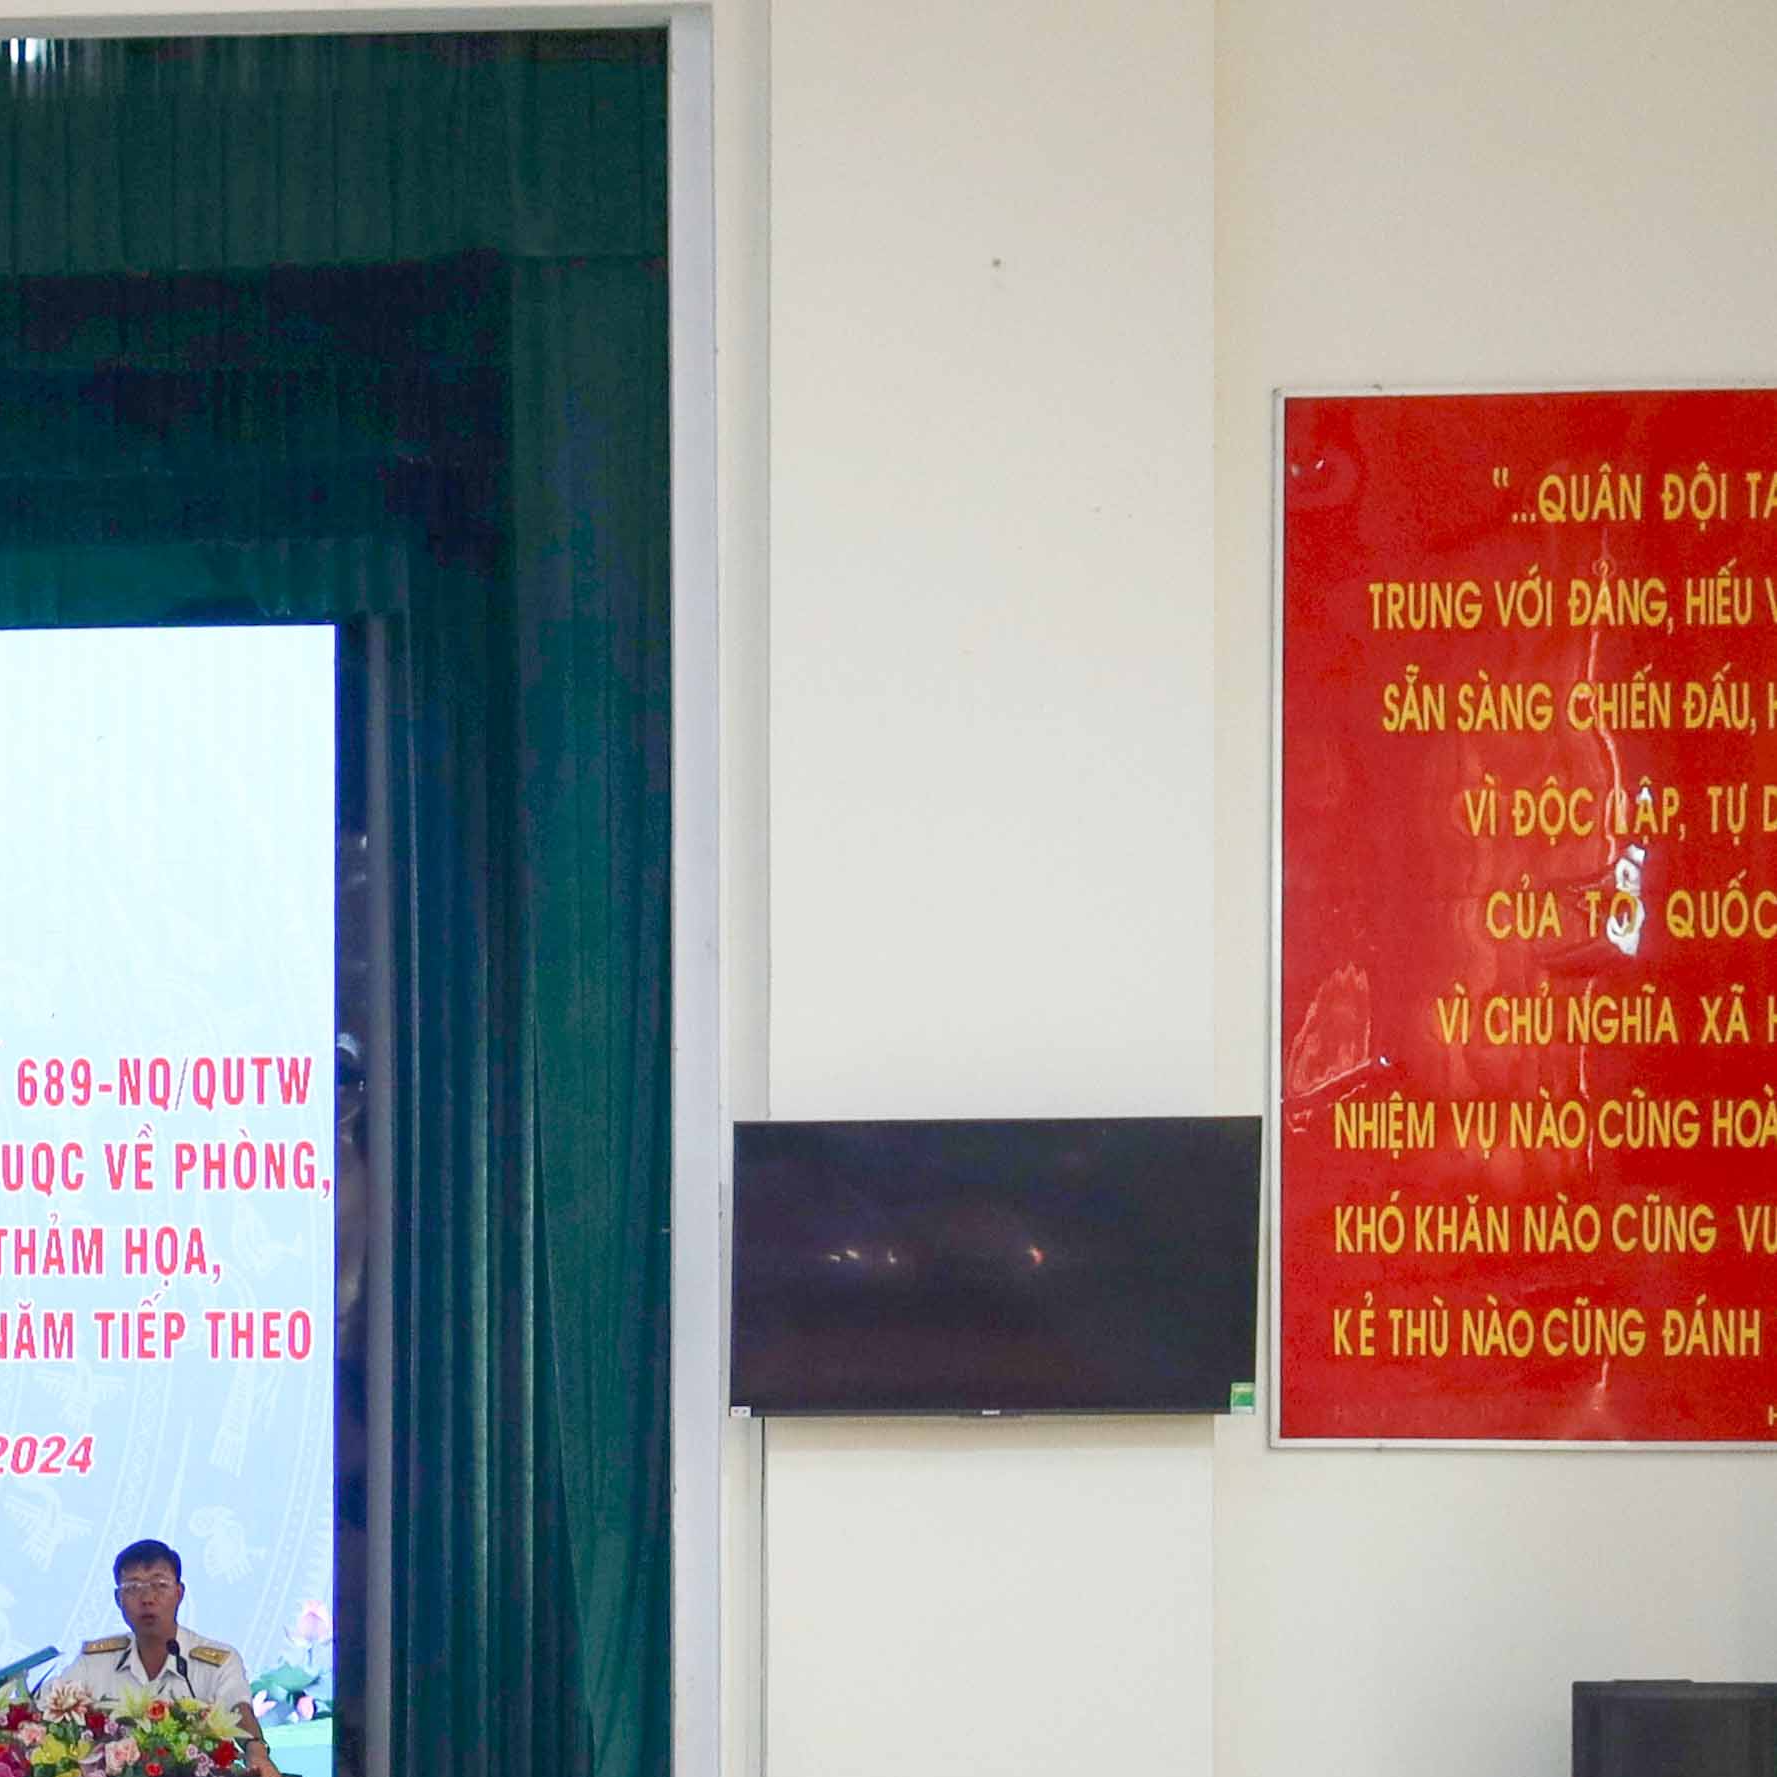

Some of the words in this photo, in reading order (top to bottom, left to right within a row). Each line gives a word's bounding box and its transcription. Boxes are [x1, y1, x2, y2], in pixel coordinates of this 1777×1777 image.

[1662, 463, 1726, 530] ĐỘI
[1369, 581, 1482, 629] TRUNG
[1495, 565, 1552, 627] VỚI
[1568, 560, 1673, 635] ĐẢNG,
[1687, 560, 1751, 624] HIẾU
[1458, 670, 1553, 731] SÀNG
[1567, 662, 1671, 730] CHIẾN
[1683, 664, 1755, 733] ĐẤU,
[1512, 776, 1594, 845] ĐỘC
[1708, 784, 1747, 844] TỰ
[1486, 874, 1562, 939] CỦA
[1667, 871, 1777, 938] QUỐC
[1437, 983, 1469, 1046] VÌ
[1485, 981, 1553, 1045] CHỦ
[1568, 983, 1678, 1044] NGHĨA
[1701, 984, 1749, 1043] XÃ
[18, 1057, 312, 1110] 689-NQ/QUTW
[1335, 1088, 1434, 1158] NHIỆM
[1452, 1102, 1496, 1160] VỤ
[1510, 1087, 1585, 1148] NÀO
[1599, 1088, 1699, 1148] CŨNG
[104, 1123, 155, 1190] VỀ
[174, 1128, 331, 1198] PHÒNG,
[1336, 1191, 1404, 1253] KHÓ
[1416, 1195, 1509, 1252] KHĂN
[1524, 1193, 1600, 1252] NÀO
[1613, 1194, 1716, 1252] CŨNG
[126, 1227, 221, 1286] HỌA,
[94, 1293, 185, 1359] TIẾP
[205, 1311, 312, 1360] THEO
[1389, 1296, 1448, 1357] THÙ
[1462, 1295, 1534, 1357] NÀO
[1543, 1298, 1645, 1356] CŨNG
[1662, 1295, 1759, 1355] ĐÁNH
